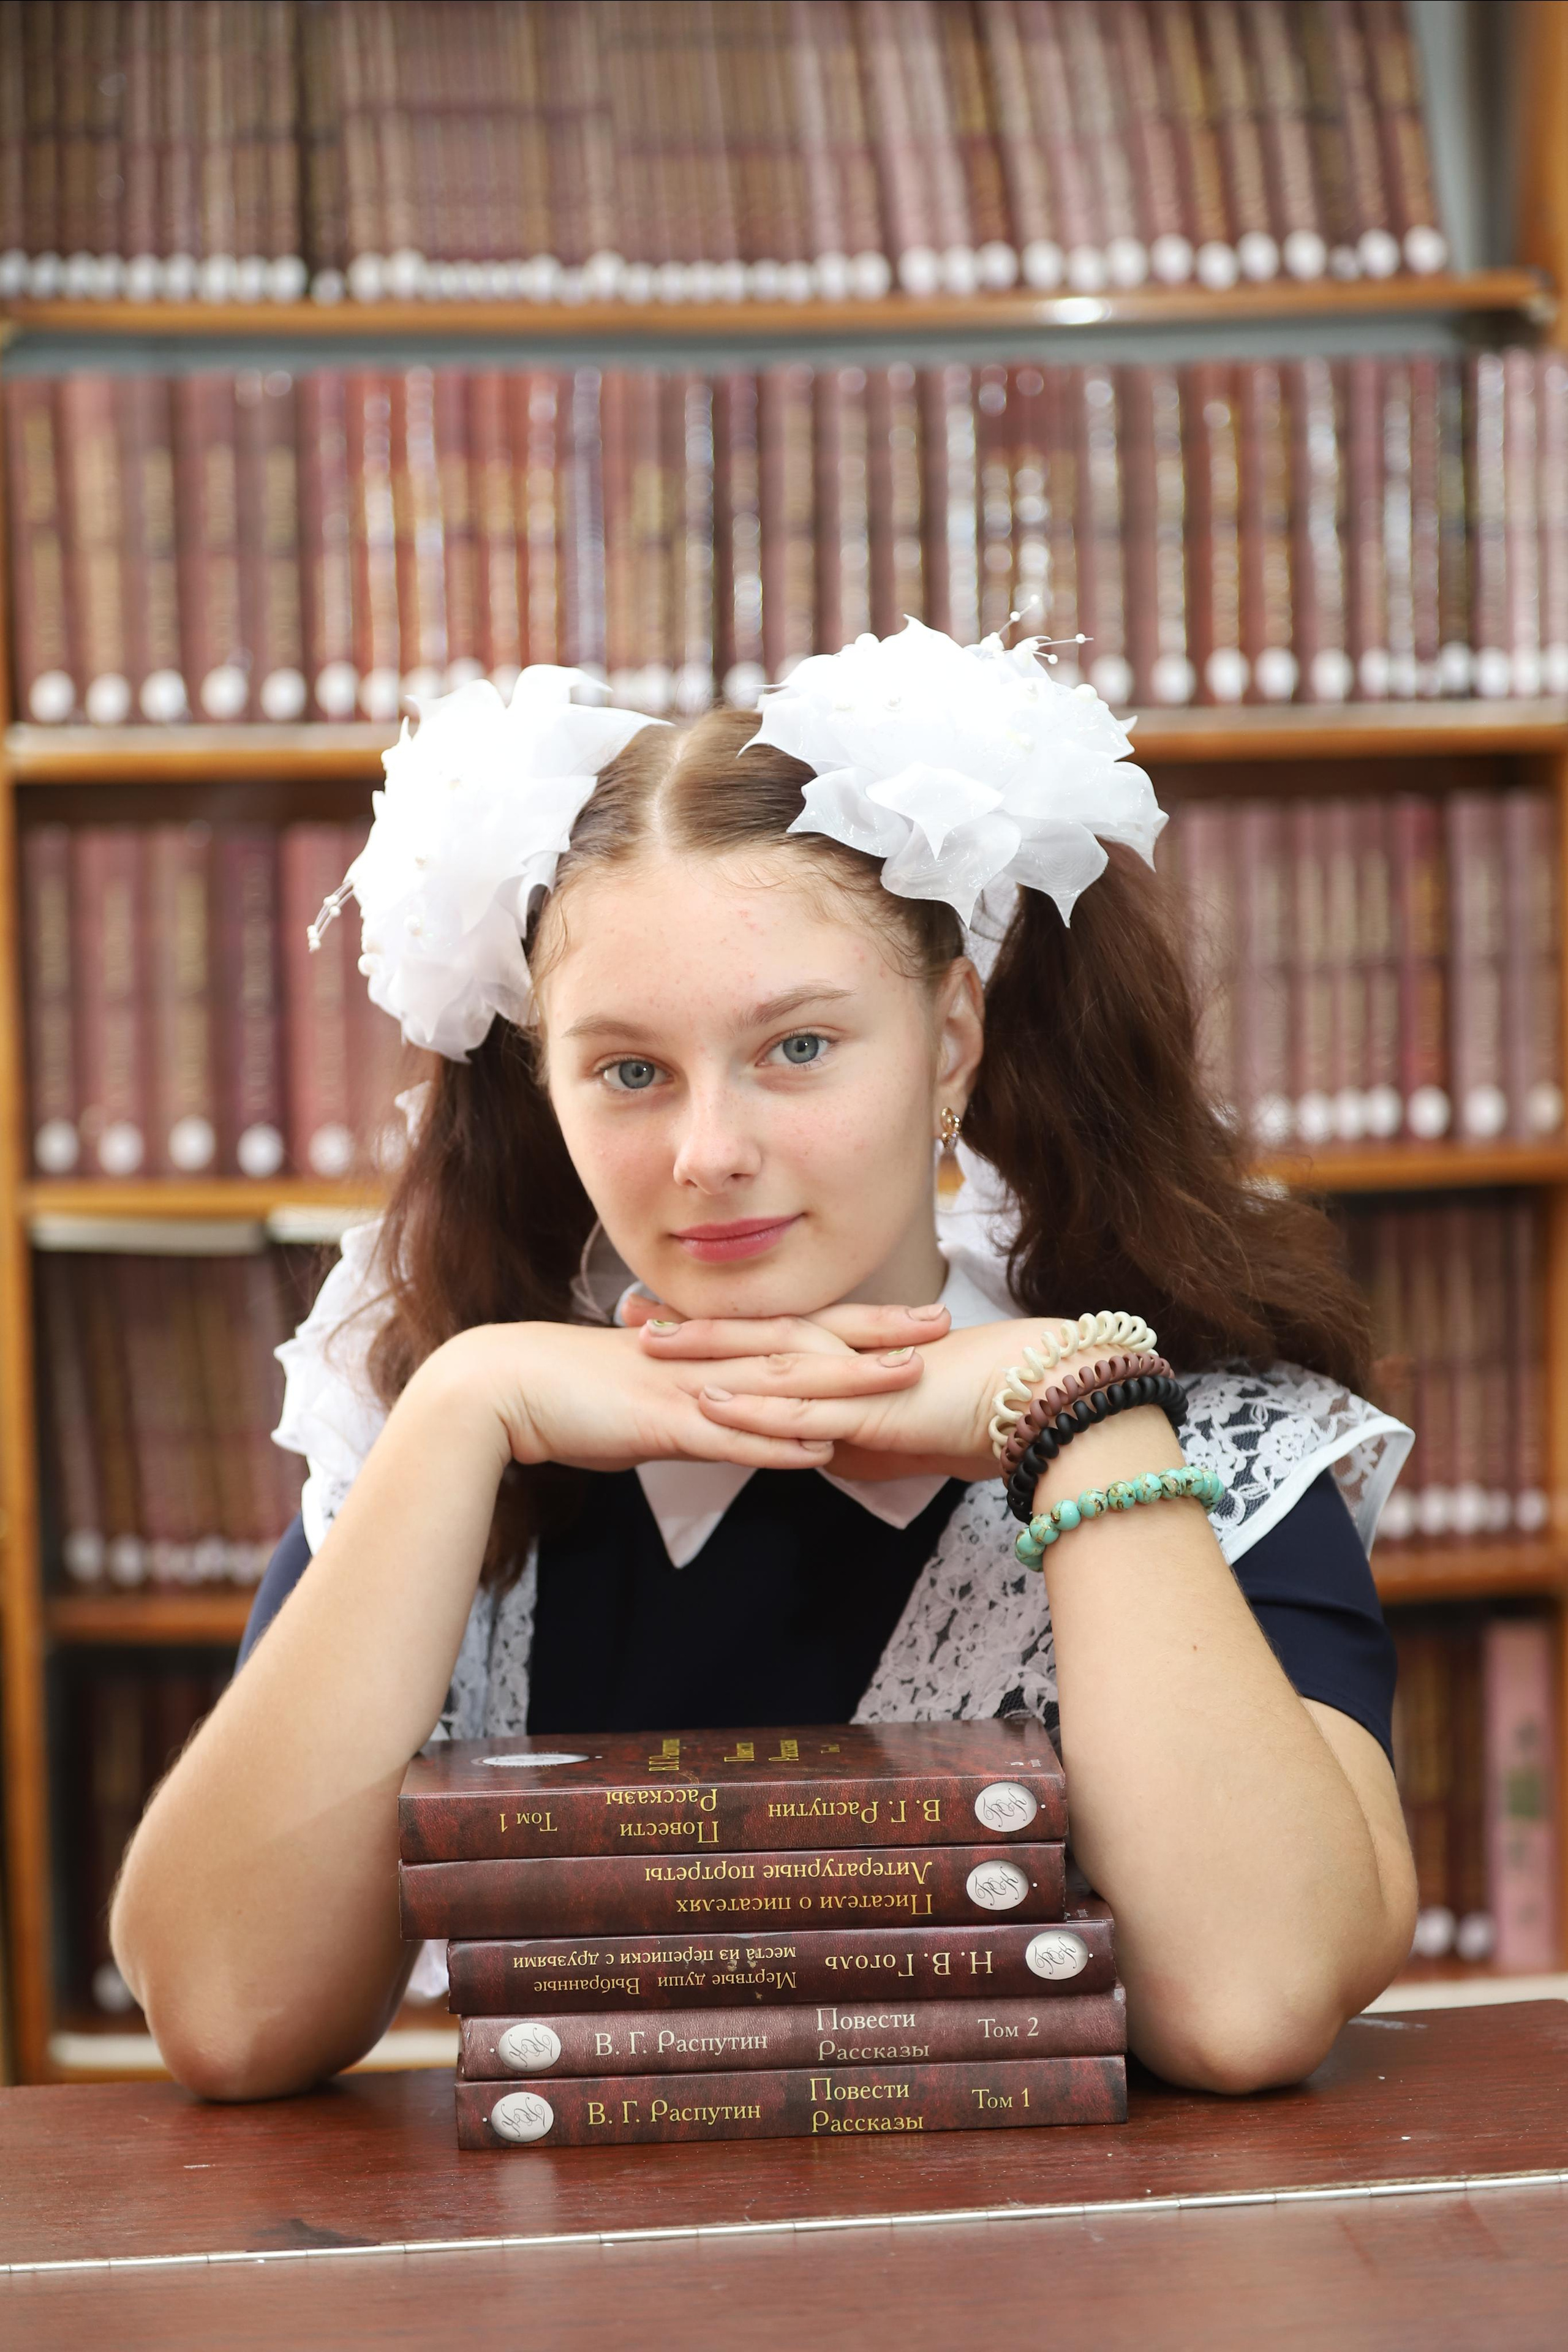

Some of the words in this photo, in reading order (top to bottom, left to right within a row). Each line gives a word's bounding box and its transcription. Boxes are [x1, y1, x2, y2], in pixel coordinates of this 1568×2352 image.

[606, 1788, 718, 1812] Рассказы
[768, 1797, 879, 1823] Распутин
[916, 1800, 941, 1822] В.
[516, 1812, 557, 1832] Том
[889, 1800, 907, 1823] Г.
[499, 1814, 508, 1833] 1
[620, 1821, 719, 1843] Повести
[644, 1860, 755, 1881] портреты
[763, 1857, 933, 1885] Литературные
[676, 1897, 791, 1912] писателях
[799, 1896, 812, 1909] о
[820, 1894, 932, 1915] Писатели
[513, 1950, 600, 1968] друзьями
[605, 1954, 614, 1965] с
[620, 1946, 714, 1964] переписки
[719, 1949, 740, 1963] из
[745, 1947, 796, 1961] места
[824, 1953, 914, 1977] Гоголь
[924, 1952, 951, 1975] В.
[960, 1951, 993, 1974] Н.
[534, 1975, 640, 1995] Выбранные
[658, 1972, 706, 1987] души
[712, 1968, 796, 1989] Мертвые
[816, 2008, 916, 2031] Повести
[977, 2018, 1019, 2038] Том
[1027, 2016, 1039, 2037] 2
[594, 2032, 620, 2056] В.
[629, 2031, 647, 2054] Г.
[658, 2030, 767, 2056] Распутин
[818, 2040, 929, 2060] Рассказы
[809, 2078, 910, 2101] Повести
[971, 2089, 1012, 2109] Том
[1021, 2087, 1030, 2107] 1
[587, 2102, 612, 2125] В.
[622, 2100, 640, 2124] Г.
[650, 2099, 761, 2125] Распутин
[812, 2110, 923, 2133] Рассказы
